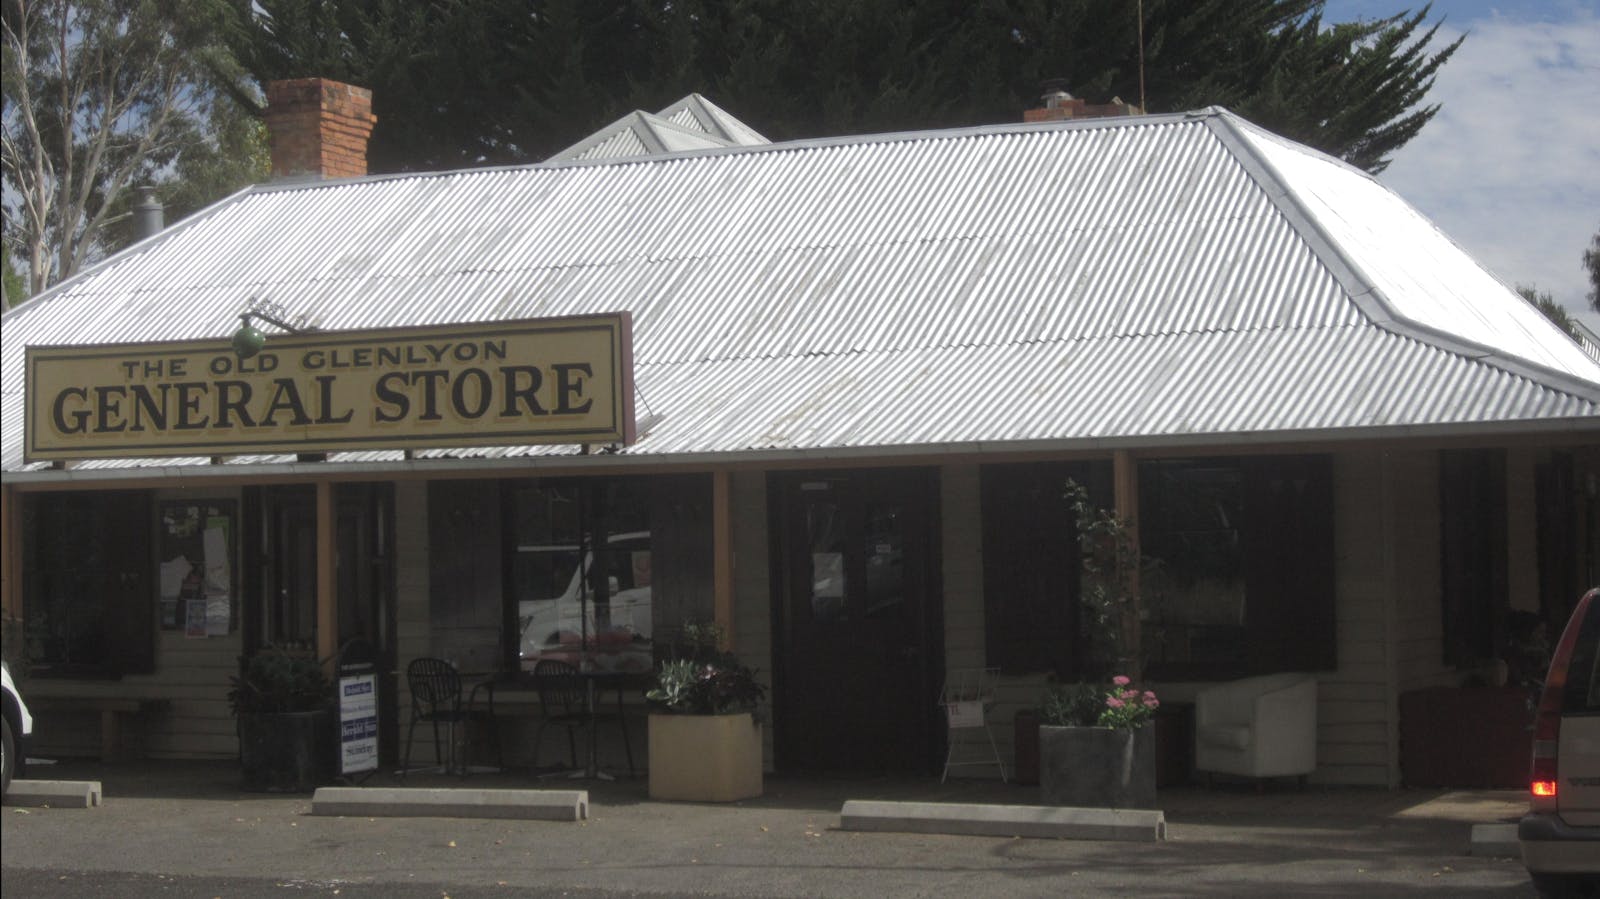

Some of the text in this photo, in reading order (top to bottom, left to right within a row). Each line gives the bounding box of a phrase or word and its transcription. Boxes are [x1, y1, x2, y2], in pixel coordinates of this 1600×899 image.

[123, 340, 507, 378] THE OLD GLENLYON
[53, 363, 593, 434] GENERAL STORE
